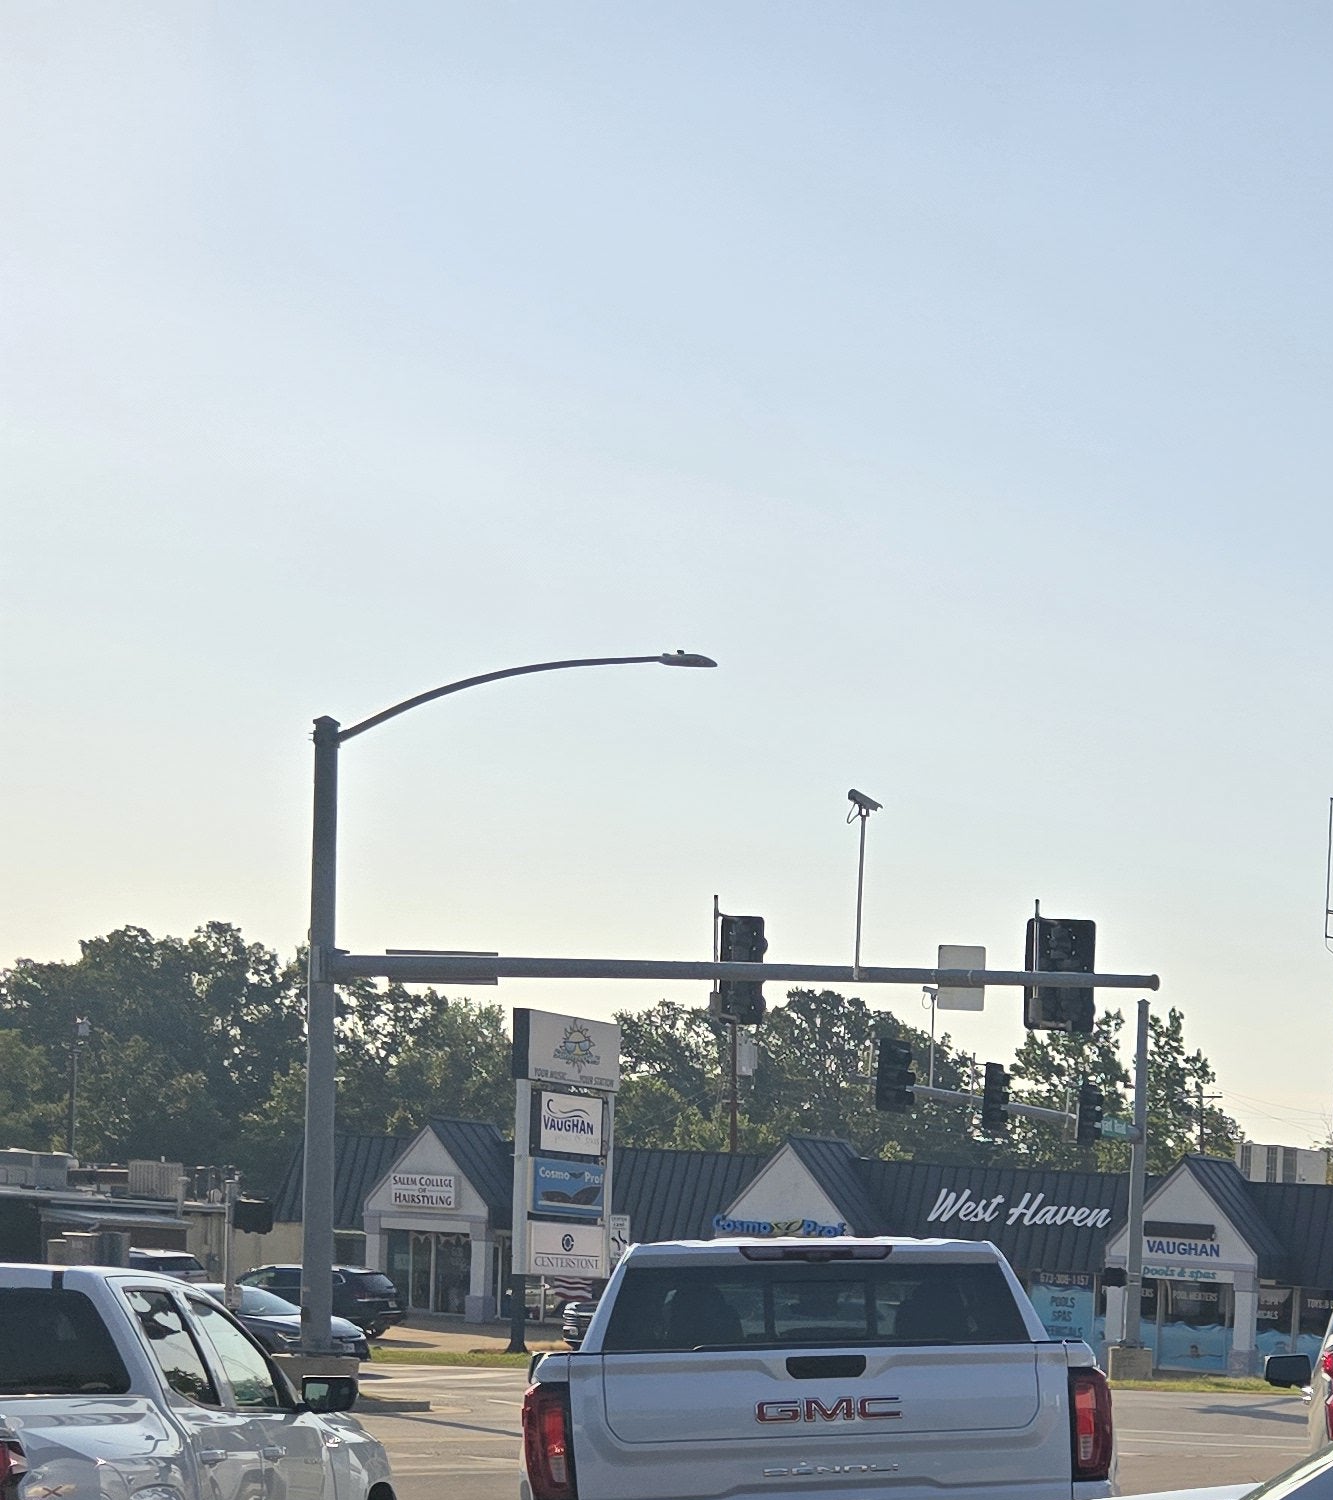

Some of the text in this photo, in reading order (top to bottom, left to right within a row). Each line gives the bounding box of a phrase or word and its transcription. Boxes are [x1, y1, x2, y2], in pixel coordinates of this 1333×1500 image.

[543, 1115, 594, 1135] VAUGHAN
[539, 1166, 570, 1180] Cosmo
[393, 1175, 452, 1188] SALEM COLLEGE
[394, 1192, 452, 1206] HAIRSTYLING
[927, 1188, 1112, 1229] West Haven
[712, 1214, 847, 1237] Cosmo Prof
[1147, 1240, 1220, 1257] VAUGHAN
[535, 1256, 600, 1270] CENTERSTONE
[1143, 1266, 1217, 1280] pools & spas
[1052, 1310, 1073, 1322] SPAS
[755, 1395, 903, 1424] GMC
